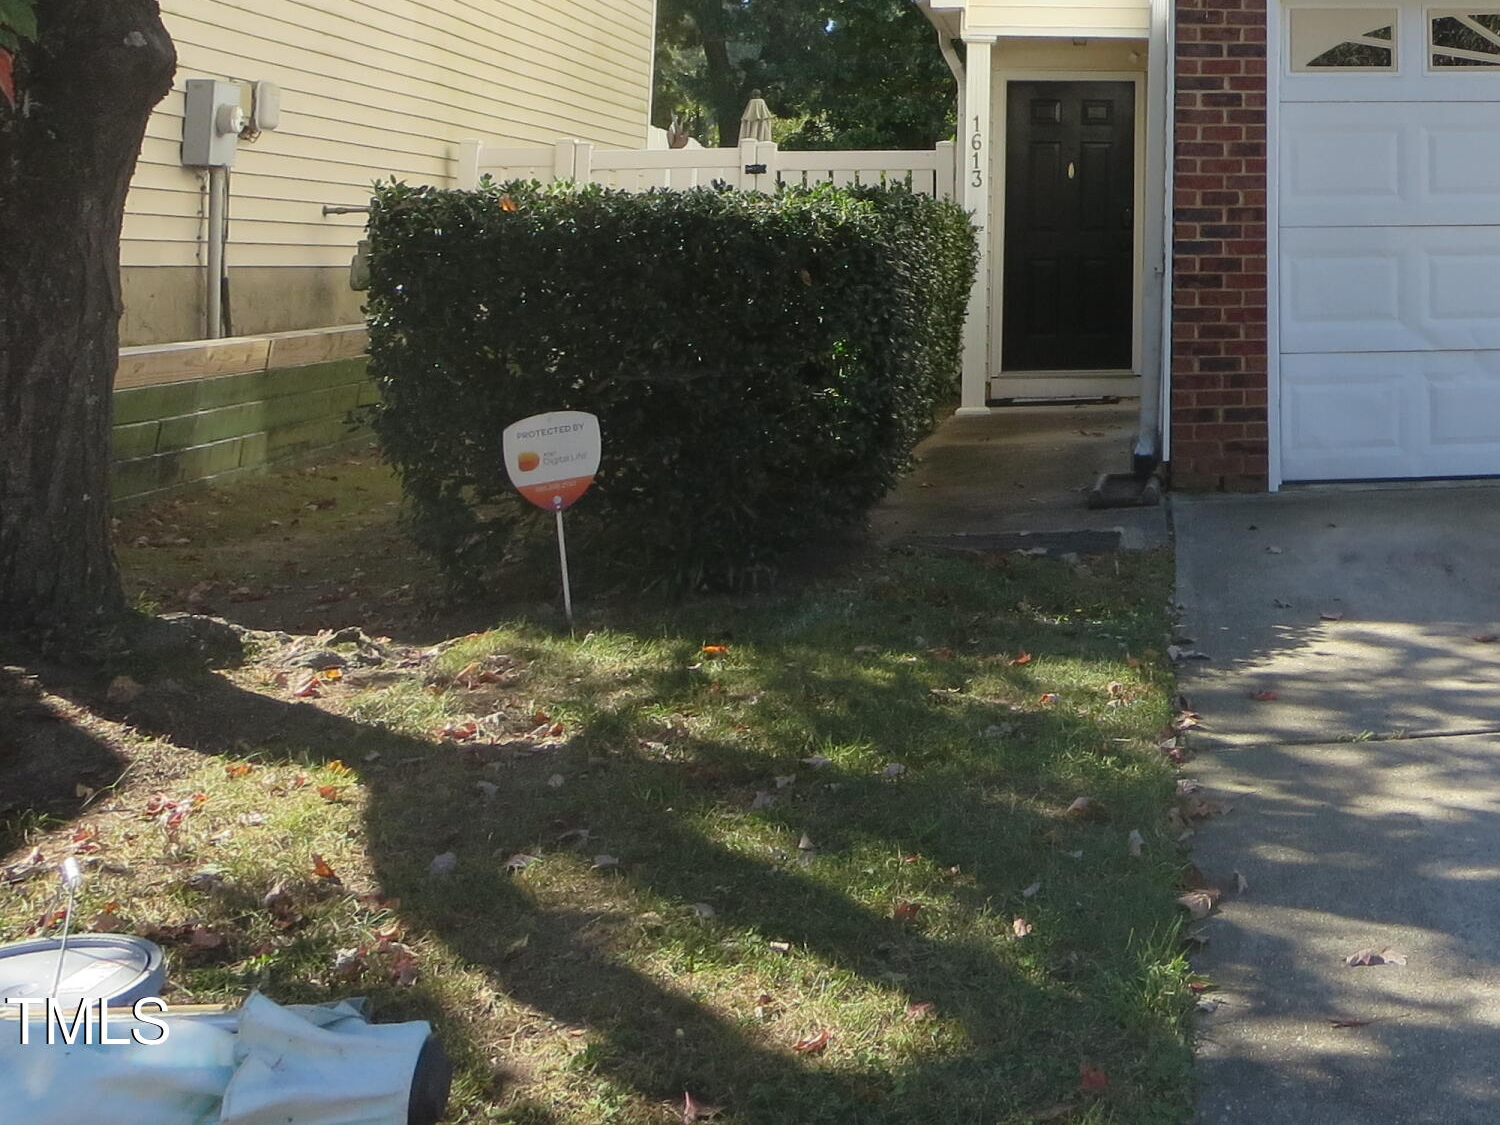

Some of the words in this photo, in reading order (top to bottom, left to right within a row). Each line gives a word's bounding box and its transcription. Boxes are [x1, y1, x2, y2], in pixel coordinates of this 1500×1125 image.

[971, 114, 983, 188] 1613
[516, 425, 572, 440] PROTECTED
[572, 423, 585, 432] BY
[543, 454, 570, 466] Digital
